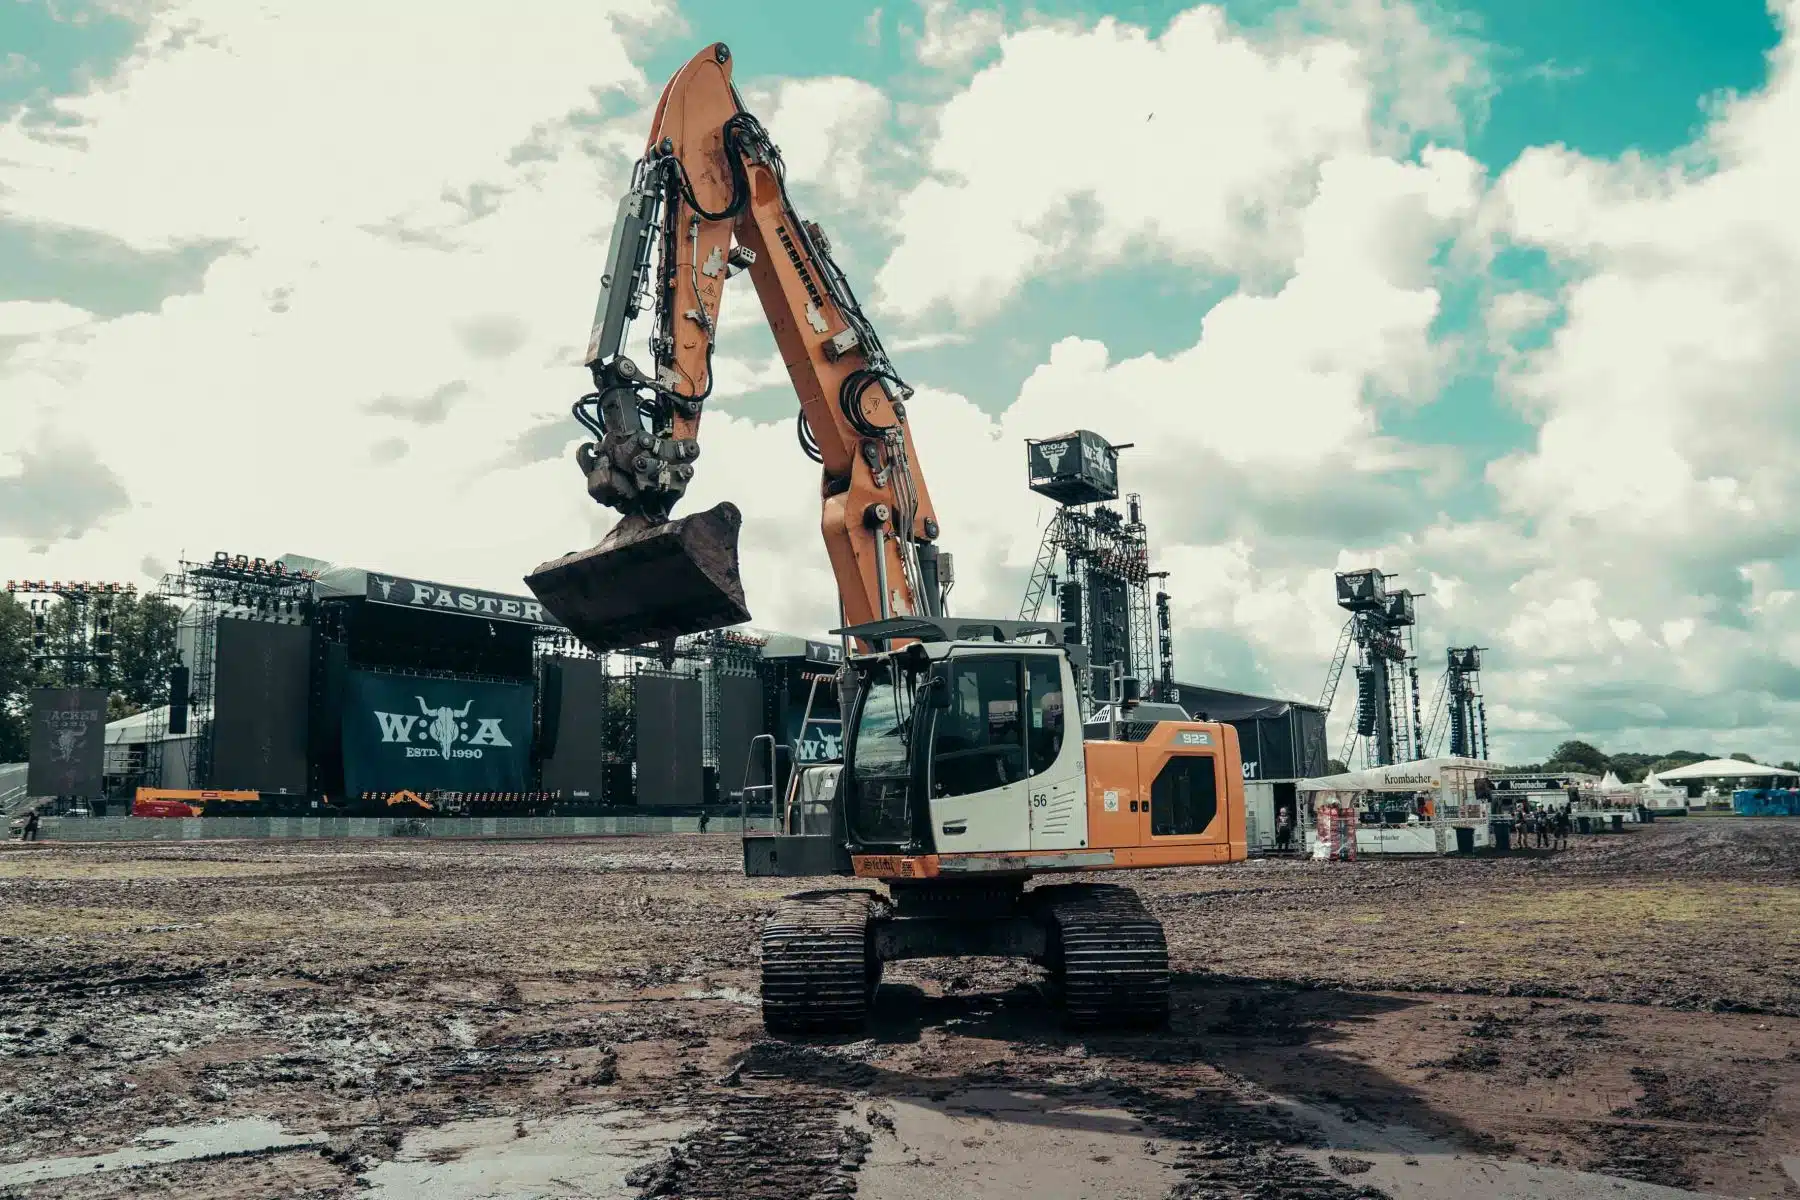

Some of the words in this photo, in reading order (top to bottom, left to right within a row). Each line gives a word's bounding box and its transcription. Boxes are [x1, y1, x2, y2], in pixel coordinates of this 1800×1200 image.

[775, 226, 824, 310] LIEBHERR
[410, 582, 544, 623] FASTER
[1183, 733, 1209, 745] 922
[405, 746, 441, 758] ESTD.
[451, 748, 483, 759] 1990
[1384, 773, 1432, 785] Krombacher
[1509, 780, 1548, 789] Krombacher
[1033, 794, 1047, 808] 56
